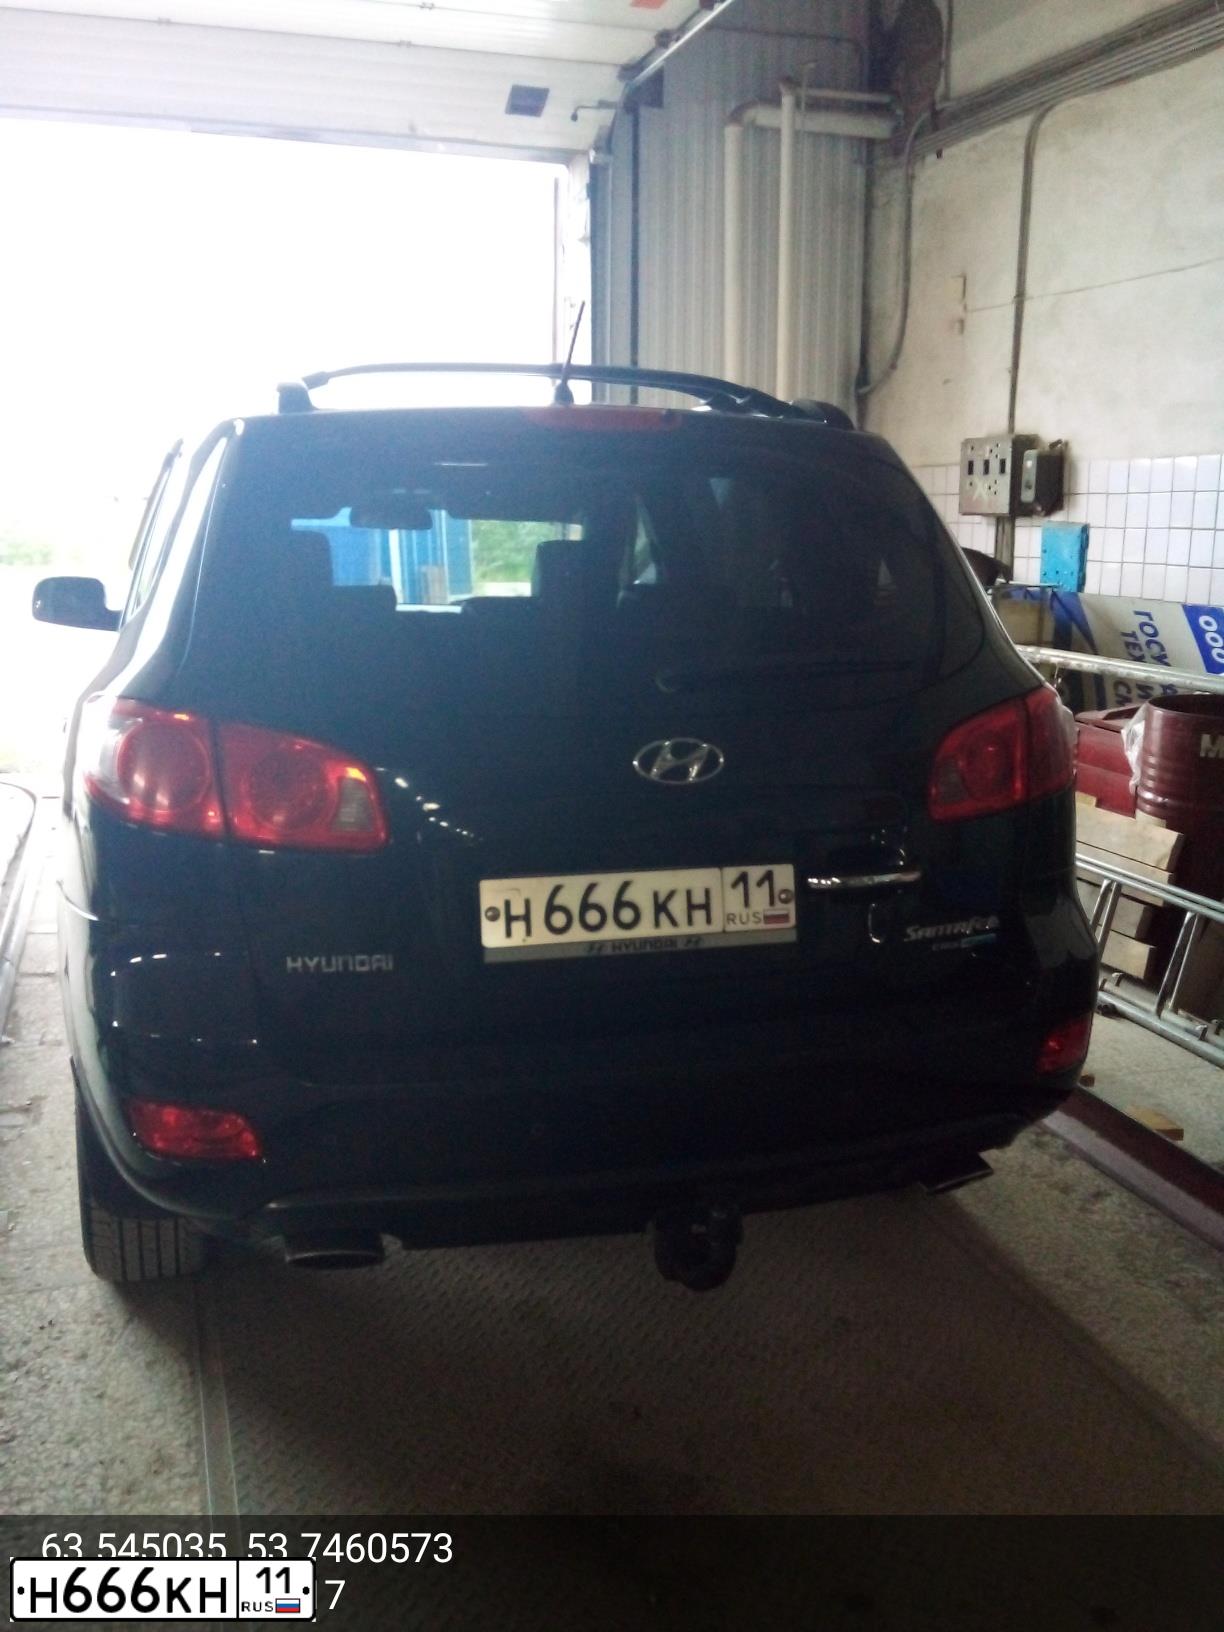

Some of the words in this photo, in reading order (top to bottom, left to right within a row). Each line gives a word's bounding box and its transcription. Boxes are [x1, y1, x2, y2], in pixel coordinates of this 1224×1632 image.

[730, 870, 776, 908] 11
[726, 912, 763, 926] RUS
[286, 954, 393, 973] HYUNDAI
